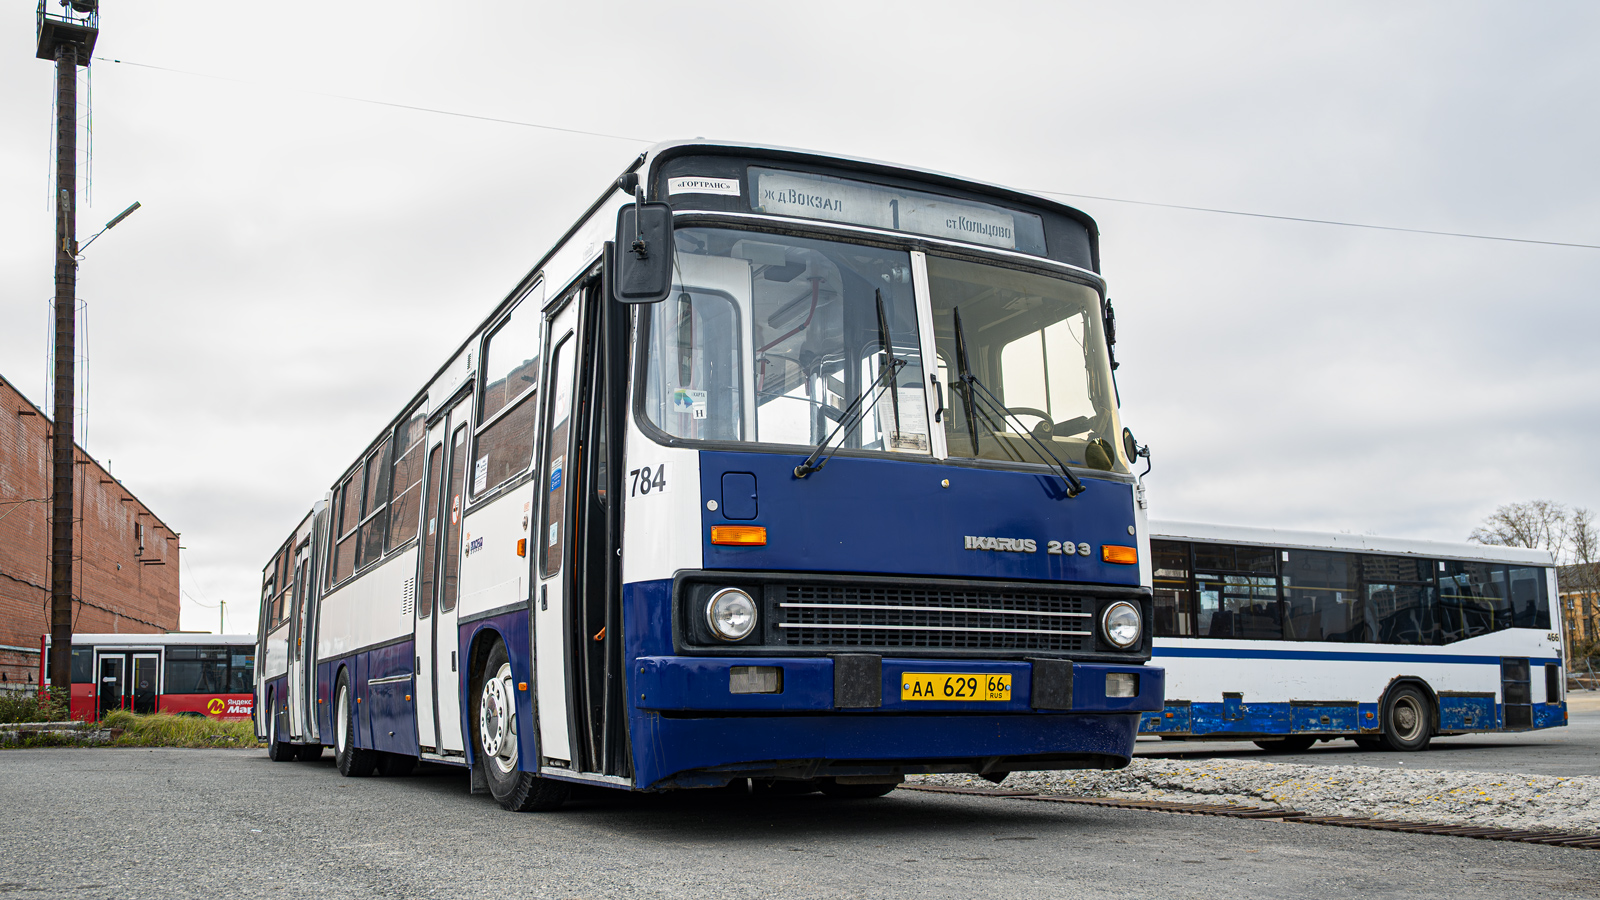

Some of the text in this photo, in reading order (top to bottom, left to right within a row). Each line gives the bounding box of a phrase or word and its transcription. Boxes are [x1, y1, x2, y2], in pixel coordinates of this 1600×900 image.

[677, 181, 730, 189] «ГОРТРАНС»
[889, 198, 900, 230] 1
[630, 464, 666, 497] 784
[964, 535, 1092, 556] IKARUS 283
[1547, 633, 1559, 641] 466
[943, 677, 978, 698] 629
[987, 676, 1005, 692] 66
